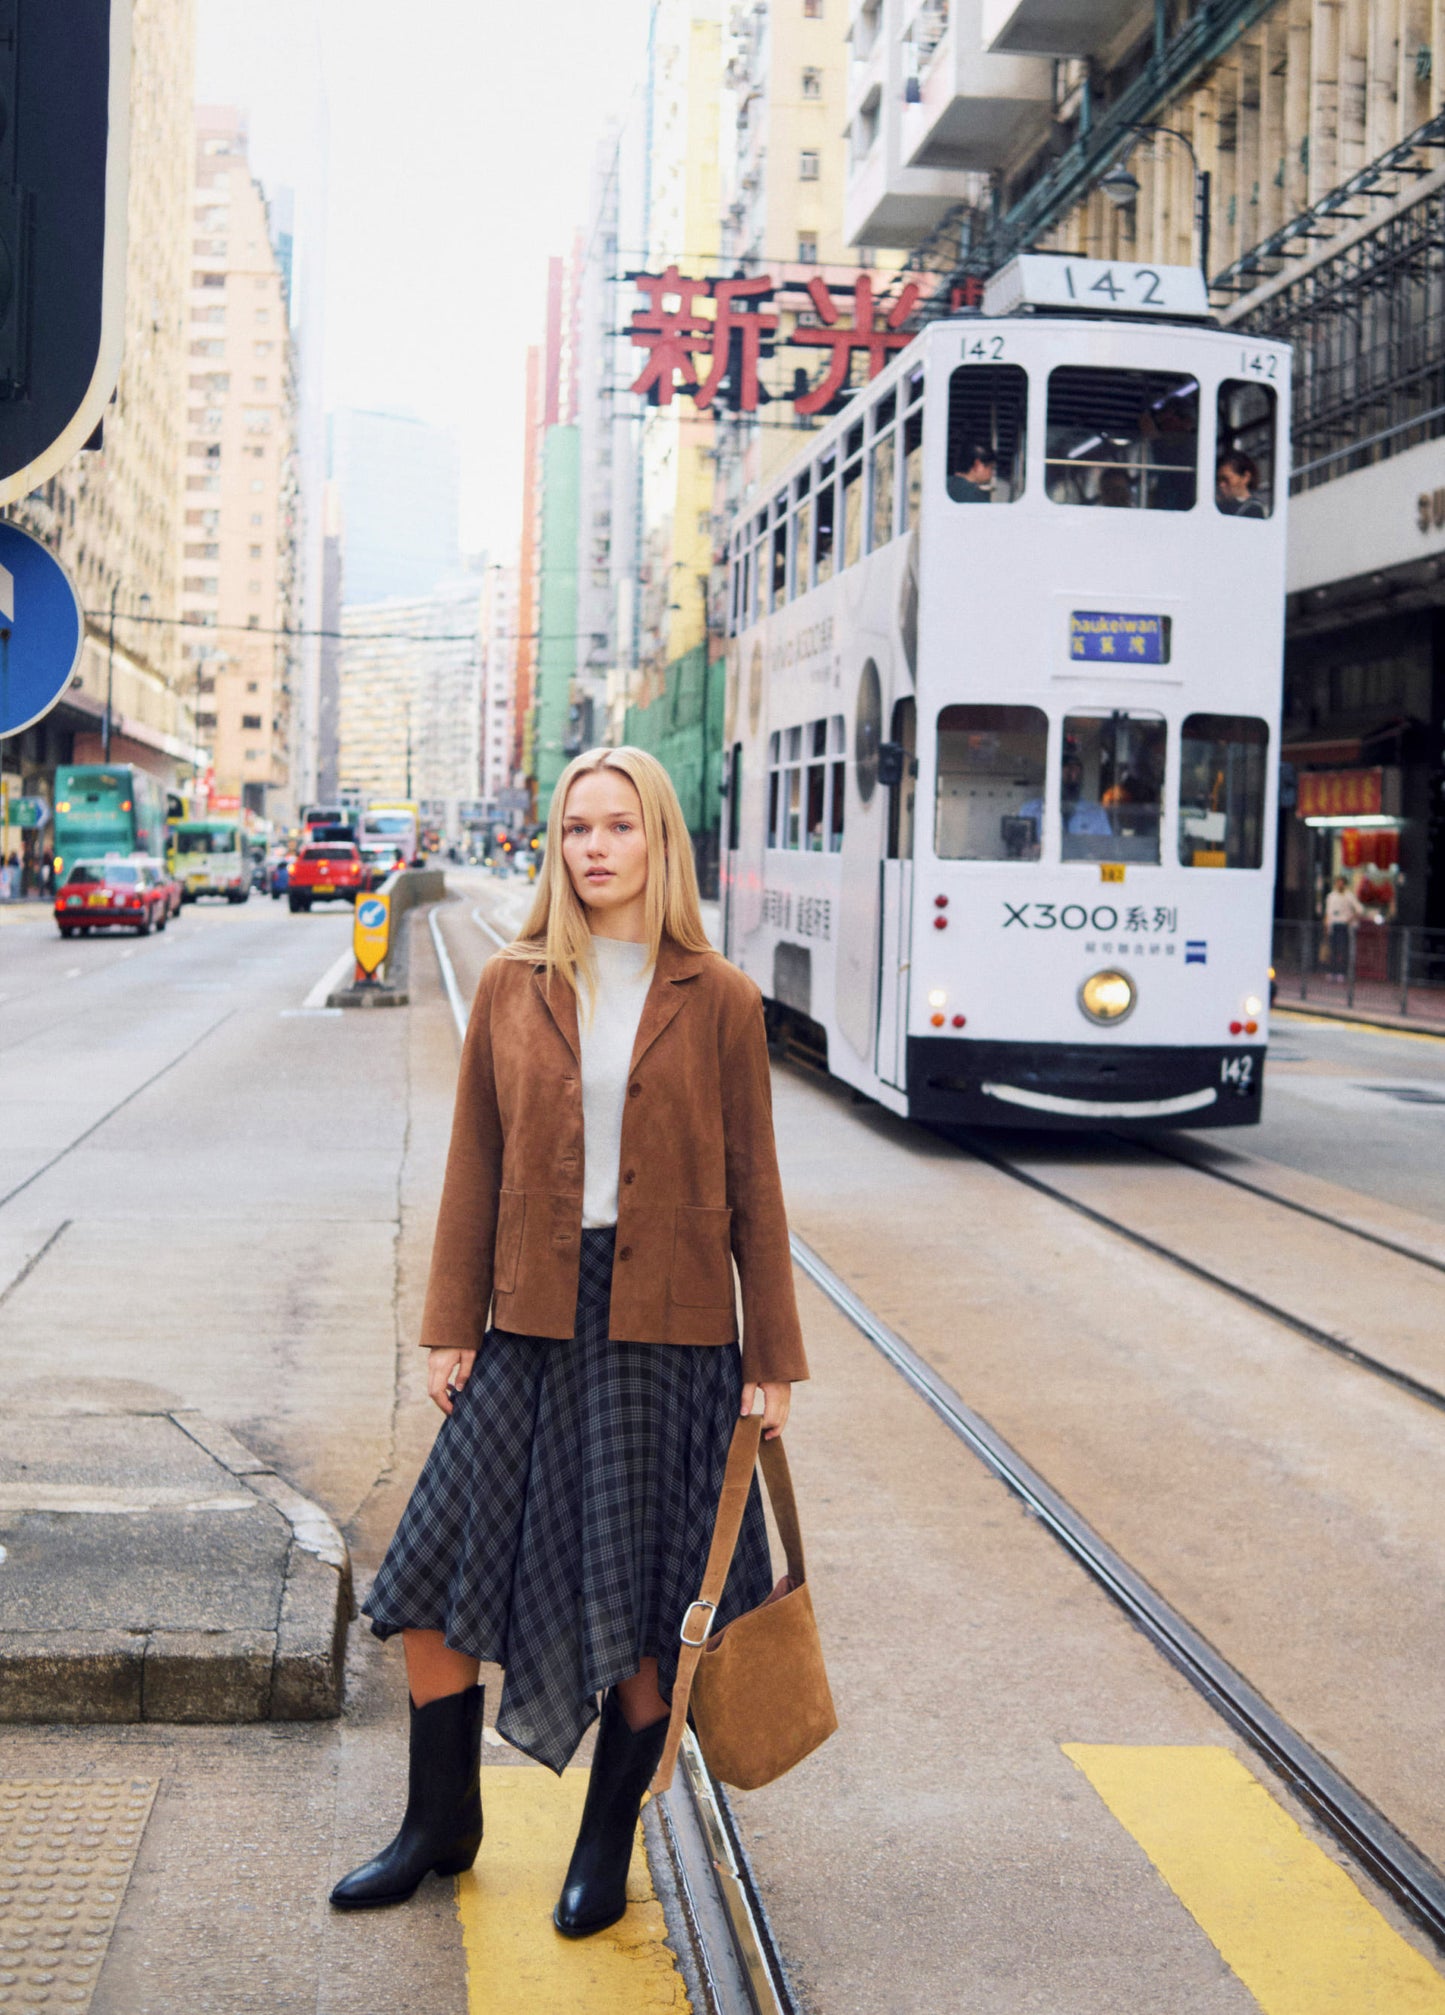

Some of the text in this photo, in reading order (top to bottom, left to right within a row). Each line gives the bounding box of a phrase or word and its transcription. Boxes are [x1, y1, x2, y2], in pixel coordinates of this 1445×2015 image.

[1065, 265, 1166, 305] 142
[631, 265, 984, 413] 新光
[960, 336, 1005, 360] 142
[1241, 351, 1279, 379] 142
[1220, 1055, 1253, 1083] 142
